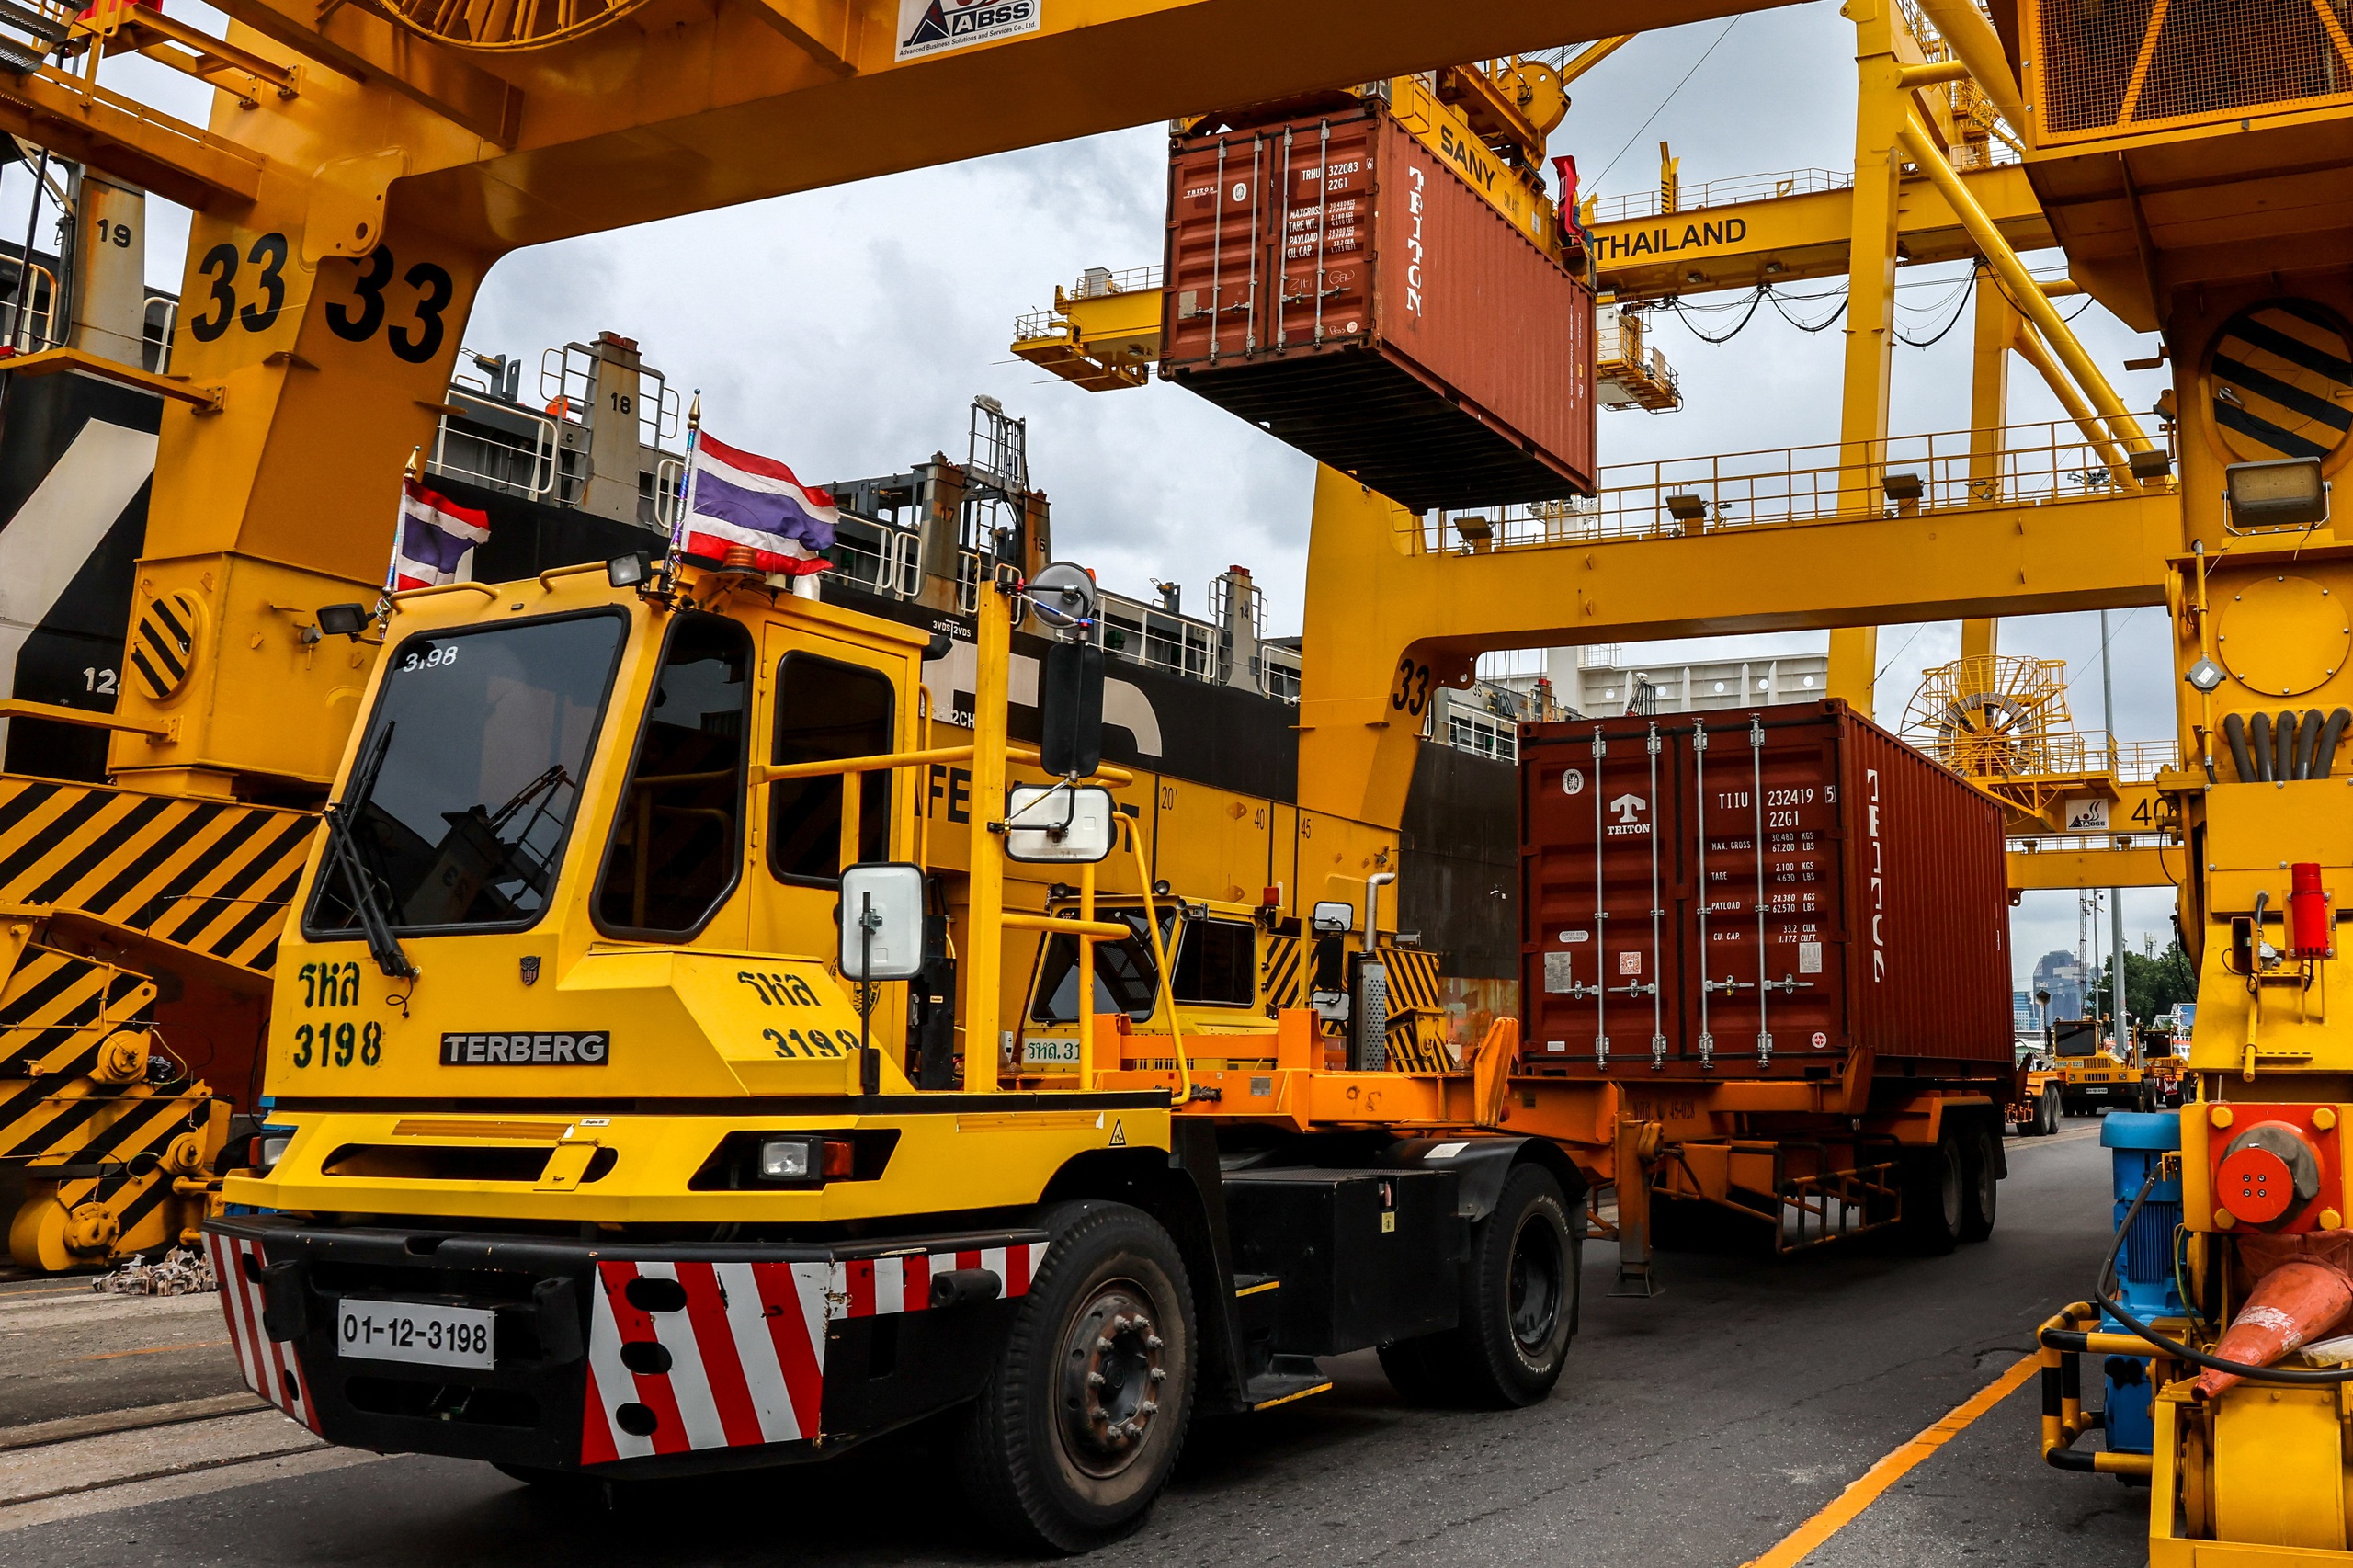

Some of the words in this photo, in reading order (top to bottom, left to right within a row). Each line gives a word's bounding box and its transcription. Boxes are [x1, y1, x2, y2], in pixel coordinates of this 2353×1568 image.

[953, 2, 1030, 34] ABSS
[899, 45, 926, 56] Advanced
[926, 40, 950, 51] Business
[951, 36, 977, 45] Solutions
[989, 27, 1012, 37] Services
[1025, 21, 1036, 29] Ltd.
[1440, 124, 1496, 192] SANY
[1302, 167, 1321, 181] TRHU
[1328, 161, 1358, 176] 322083
[1367, 158, 1373, 169] 6
[1187, 186, 1215, 196] TRITON
[1328, 177, 1348, 191] 22G1
[97, 219, 131, 248] 19
[1289, 220, 1304, 233] TARE
[1305, 218, 1317, 230] WT.
[1289, 232, 1318, 246] PAYLOAD
[1406, 165, 1425, 317] TRITON
[1593, 218, 1747, 261] THAILAND
[1299, 245, 1314, 257] CAP.
[190, 232, 289, 343] 33
[324, 243, 453, 364] 33
[610, 392, 631, 415] 18
[1032, 537, 1047, 552] 15
[1239, 605, 1250, 621] 14
[932, 620, 951, 632] 3VDS
[953, 625, 972, 638] 2VDS
[83, 666, 120, 696] 12
[1392, 658, 1430, 716] 33
[1718, 791, 1748, 810] TIIU
[1768, 788, 1813, 807] 232419
[1825, 786, 1835, 802] 5
[1769, 810, 1799, 828] 22G1
[1607, 824, 1651, 835] TRITON
[1771, 832, 1794, 842] 30.480
[1802, 832, 1814, 840] KGS
[1711, 842, 1728, 851] MAX.
[1730, 840, 1751, 850] GROSS
[1772, 843, 1795, 853] 67.200
[1802, 842, 1814, 851] LBS
[1775, 862, 1794, 872] 2.100
[1802, 861, 1814, 870] KGS
[1711, 871, 1728, 881] TARE
[1776, 873, 1795, 882] 4.630
[1802, 872, 1815, 881] LBS
[1772, 893, 1796, 903] 28.380
[1802, 892, 1815, 902] KGS
[1711, 901, 1741, 910] PAYLOAD
[1772, 903, 1796, 913] 62.570
[1802, 903, 1815, 912] LBS
[1783, 924, 1798, 934] 33.2
[1713, 933, 1724, 941] CU.
[1779, 935, 1797, 944] 1.172
[293, 1020, 383, 1069] 3198
[443, 1035, 605, 1062] TERBERG
[343, 1313, 488, 1354] 01-12-3198
